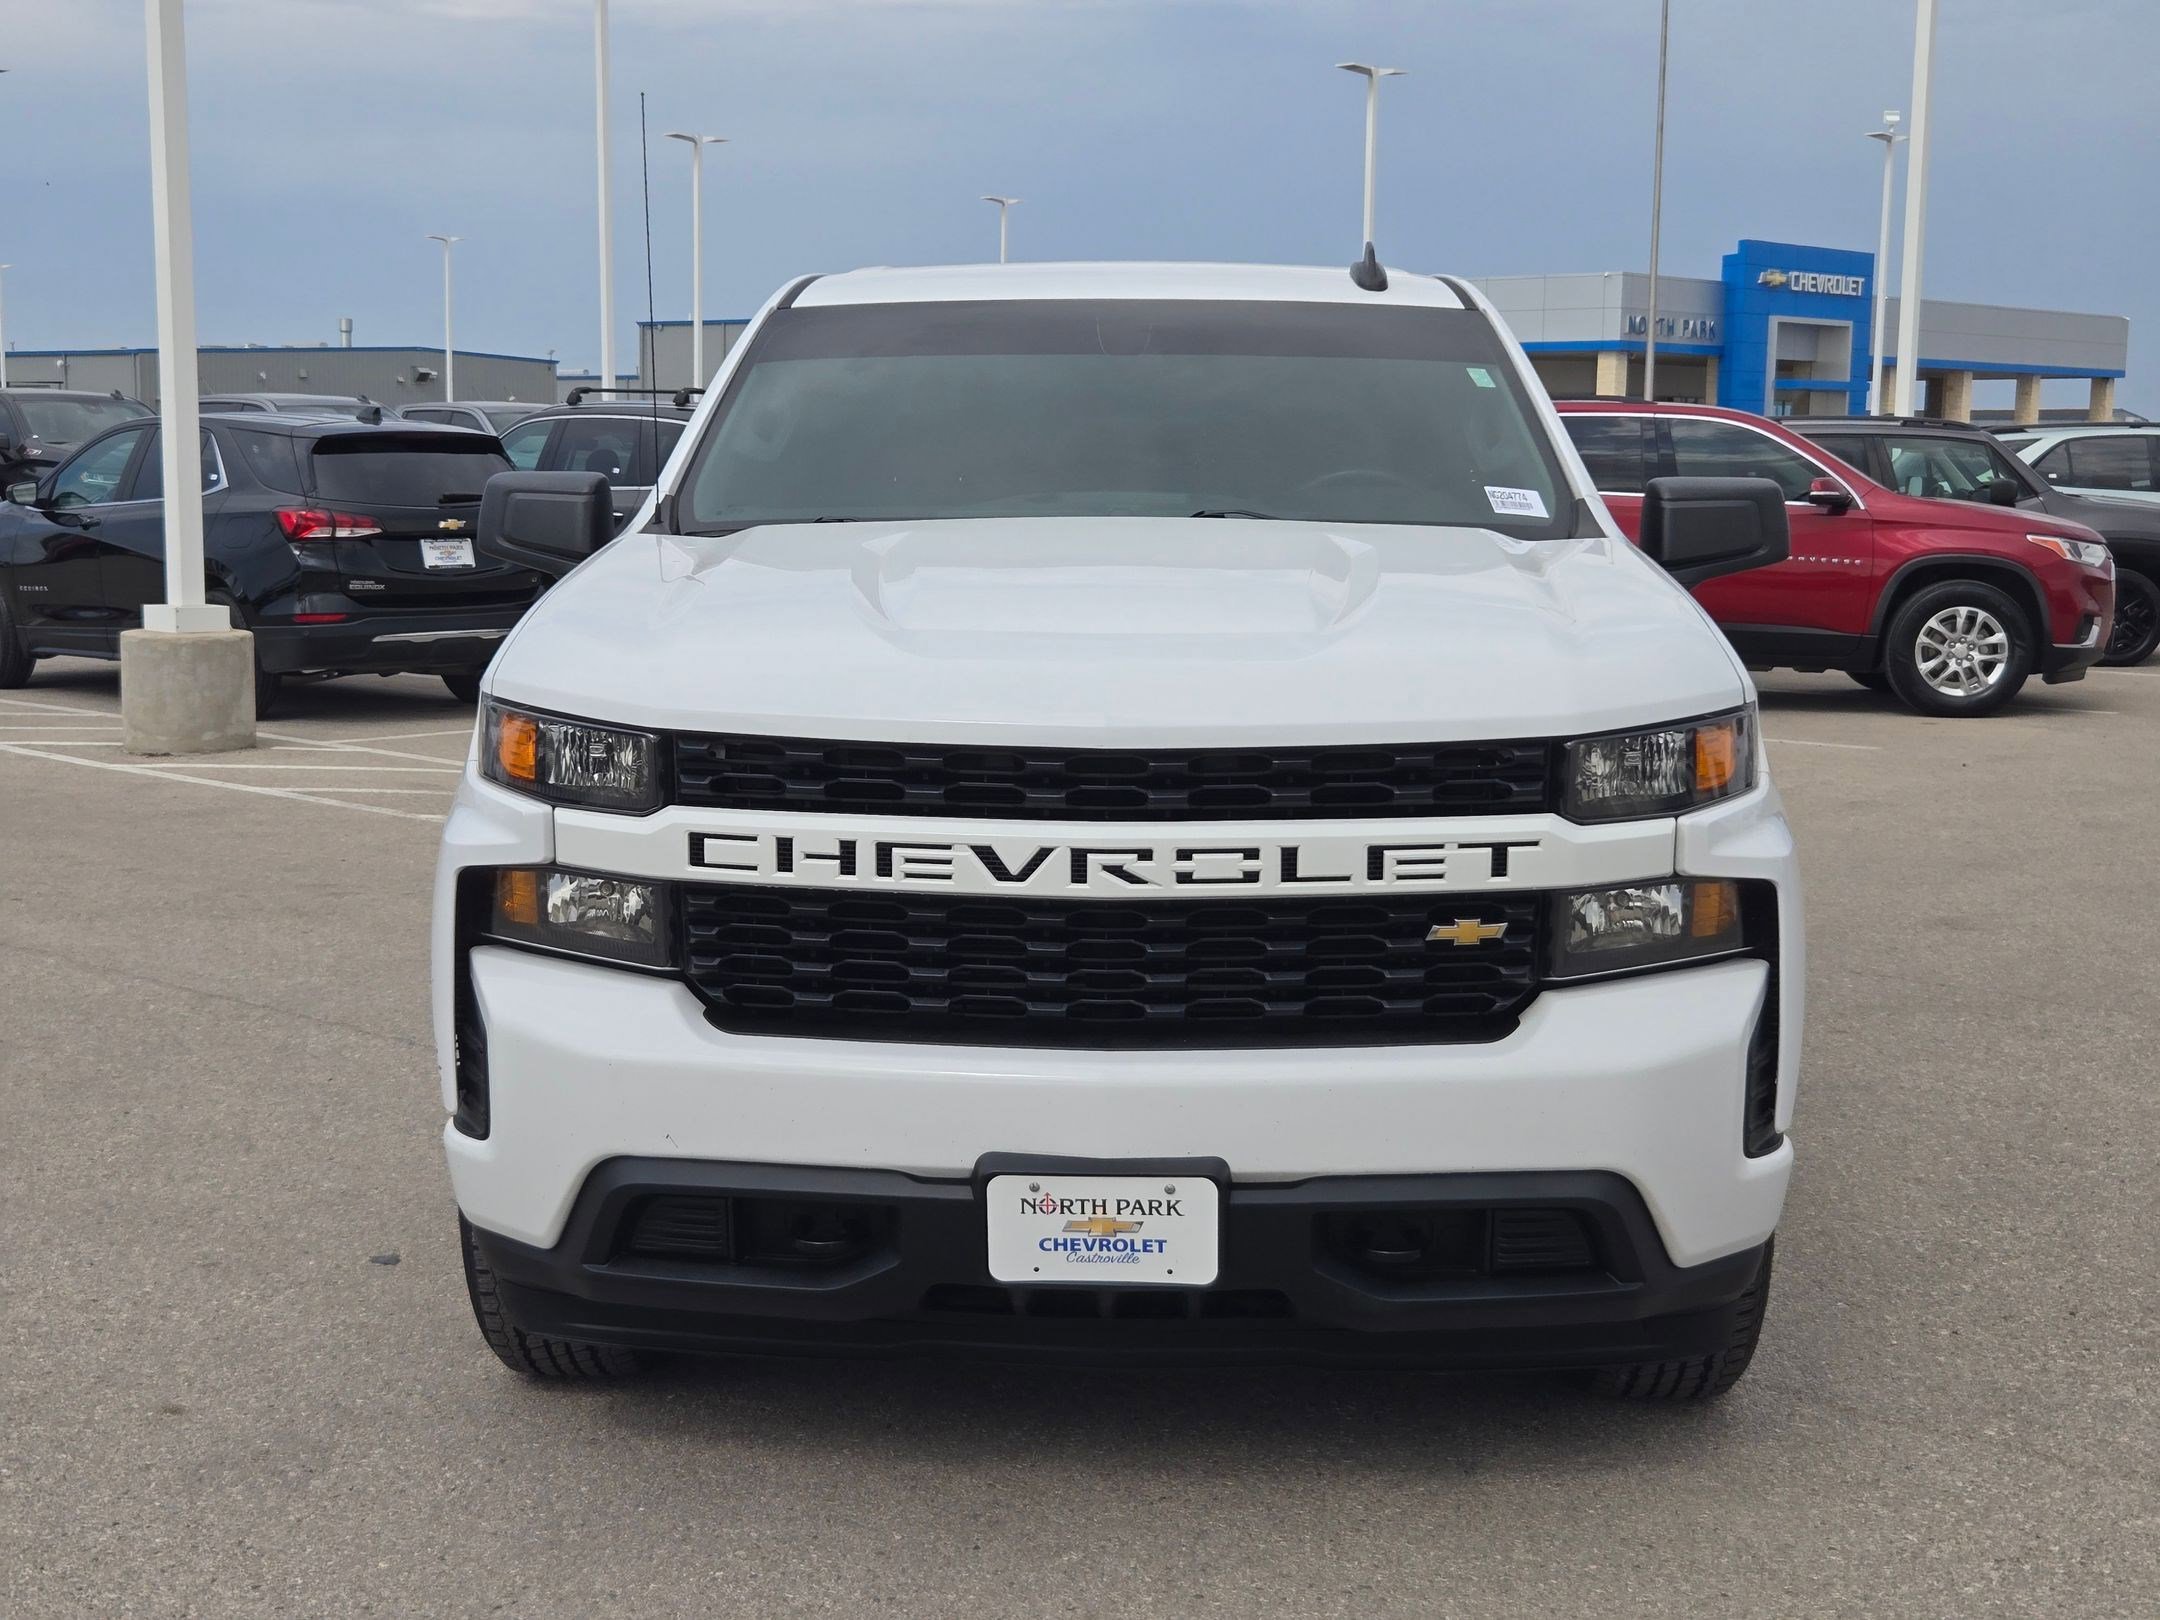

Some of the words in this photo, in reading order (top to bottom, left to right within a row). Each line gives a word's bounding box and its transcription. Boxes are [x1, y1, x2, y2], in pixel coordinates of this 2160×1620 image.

[1789, 271, 1865, 297] CHEVROLET
[1628, 315, 1675, 337] NOTH
[1682, 319, 1716, 339] PARK
[688, 831, 1540, 888] CHEVROLET
[1020, 1196, 1107, 1216] NORTH
[1116, 1199, 1185, 1217] PARK
[1038, 1237, 1168, 1254] CHEVROLET
[1066, 1251, 1141, 1265] Castroville
